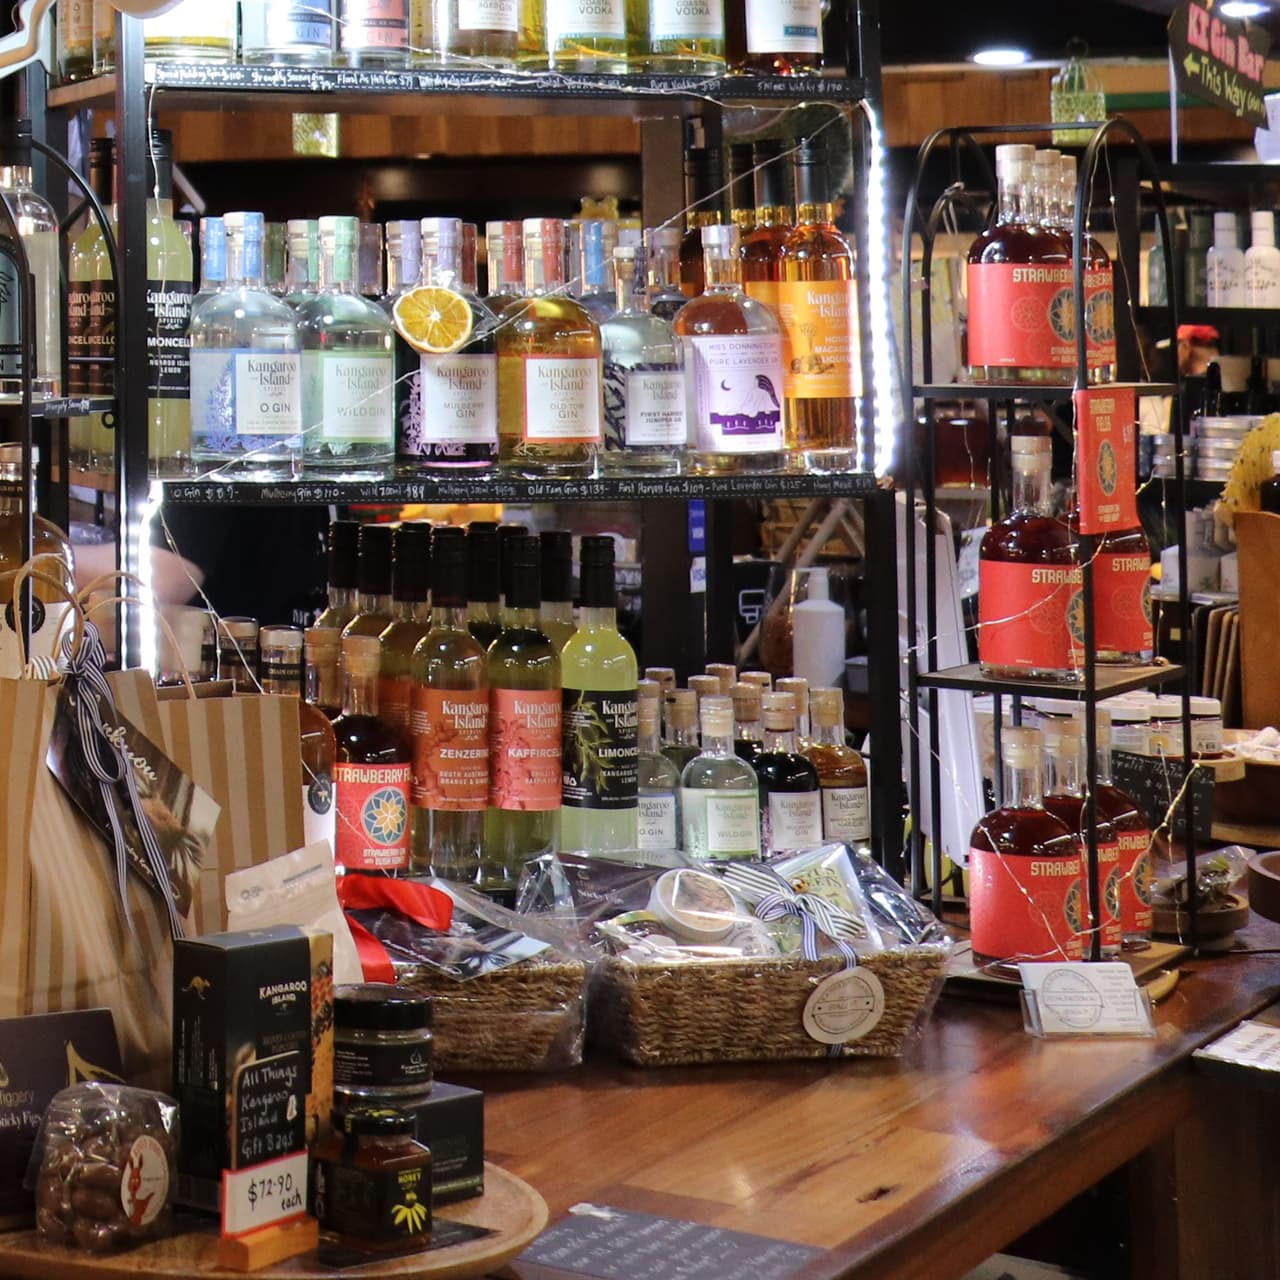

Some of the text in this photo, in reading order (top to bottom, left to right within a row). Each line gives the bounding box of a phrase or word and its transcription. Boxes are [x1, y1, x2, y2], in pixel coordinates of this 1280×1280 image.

[579, 6, 614, 16] VODKA
[676, 7, 711, 17] VODKA
[1210, 17, 1236, 69] Gin
[1237, 33, 1265, 82] Bar
[1200, 54, 1223, 96] This
[1224, 70, 1246, 118] Way
[154, 303, 188, 318] Island
[247, 359, 297, 374] Kangaroo
[335, 363, 387, 379] Kangaroo
[436, 365, 490, 381] Kangaroo
[537, 363, 592, 380] Kangaroo
[258, 372, 291, 386] Island
[347, 376, 379, 391] Island
[447, 377, 483, 391] Island
[548, 377, 586, 392] Island
[271, 403, 291, 413] GIN
[336, 406, 386, 418] WILD GIN
[455, 408, 476, 419] GIN
[557, 410, 579, 420] GIN
[453, 714, 485, 730] Island
[525, 714, 558, 730] Island
[647, 827, 665, 837] GIN
[259, 980, 308, 1000] KANGAROO
[271, 993, 297, 1005] ISLAND
[240, 1063, 299, 1088] All Things
[239, 1091, 288, 1113] Kangaroo
[239, 1110, 278, 1134] Island
[240, 1140, 264, 1160] Gift
[397, 1171, 423, 1185] HONEY
[280, 1193, 303, 1212] each
